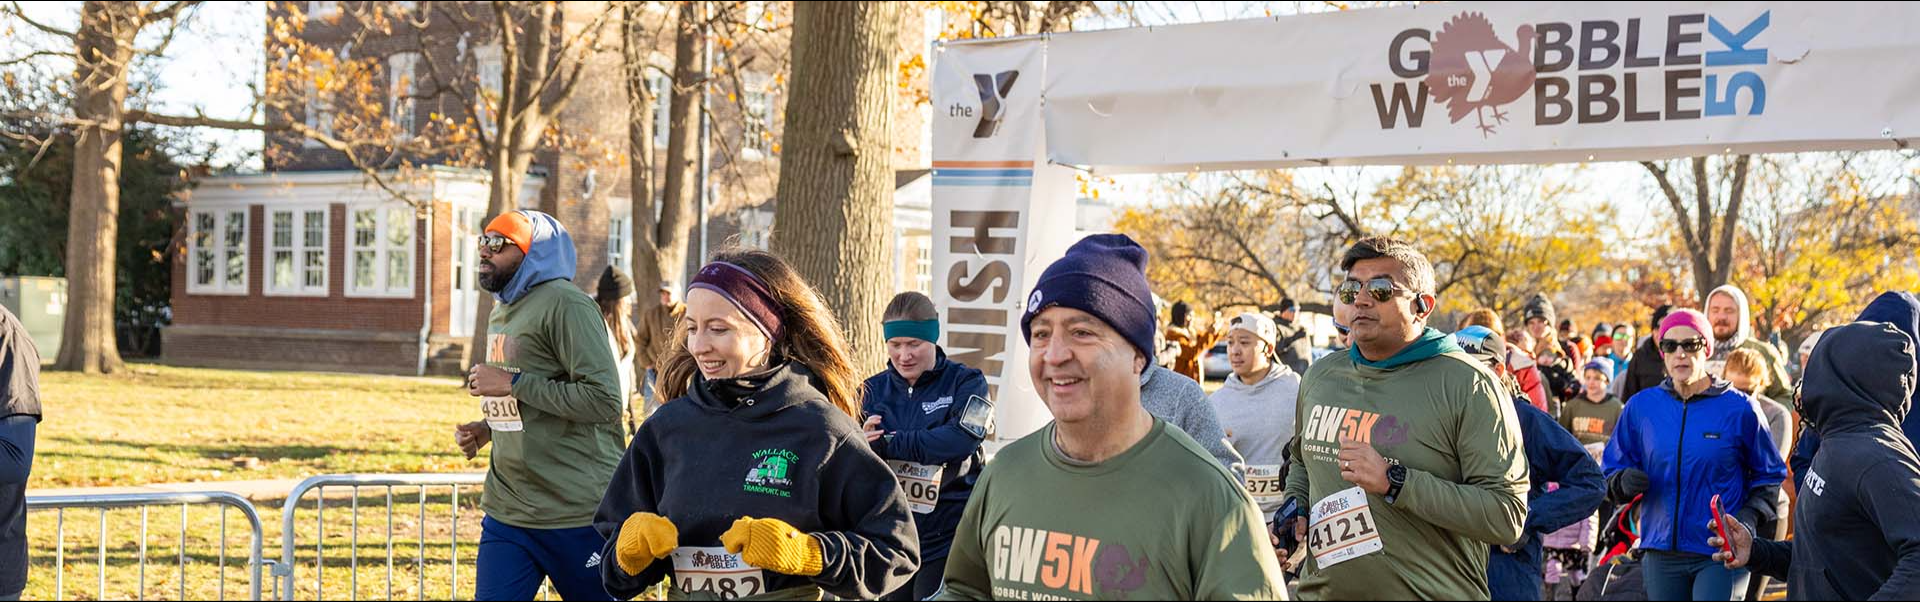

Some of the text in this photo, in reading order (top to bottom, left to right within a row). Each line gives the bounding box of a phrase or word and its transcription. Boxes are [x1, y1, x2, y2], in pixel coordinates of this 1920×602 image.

[1447, 49, 1506, 102] the Y
[1704, 10, 1770, 117] 5K
[950, 102, 973, 118] the
[973, 69, 1019, 138] Y
[946, 210, 1020, 441] NISH
[482, 400, 518, 417] 4310
[1304, 404, 1380, 444] GW5K
[752, 448, 799, 464] WALLACE
[1303, 444, 1330, 454] GOBBLE
[1246, 479, 1280, 493] 375
[1310, 512, 1374, 550] 4121
[993, 525, 1100, 595] GW5K
[994, 586, 1028, 600] GOBBLE
